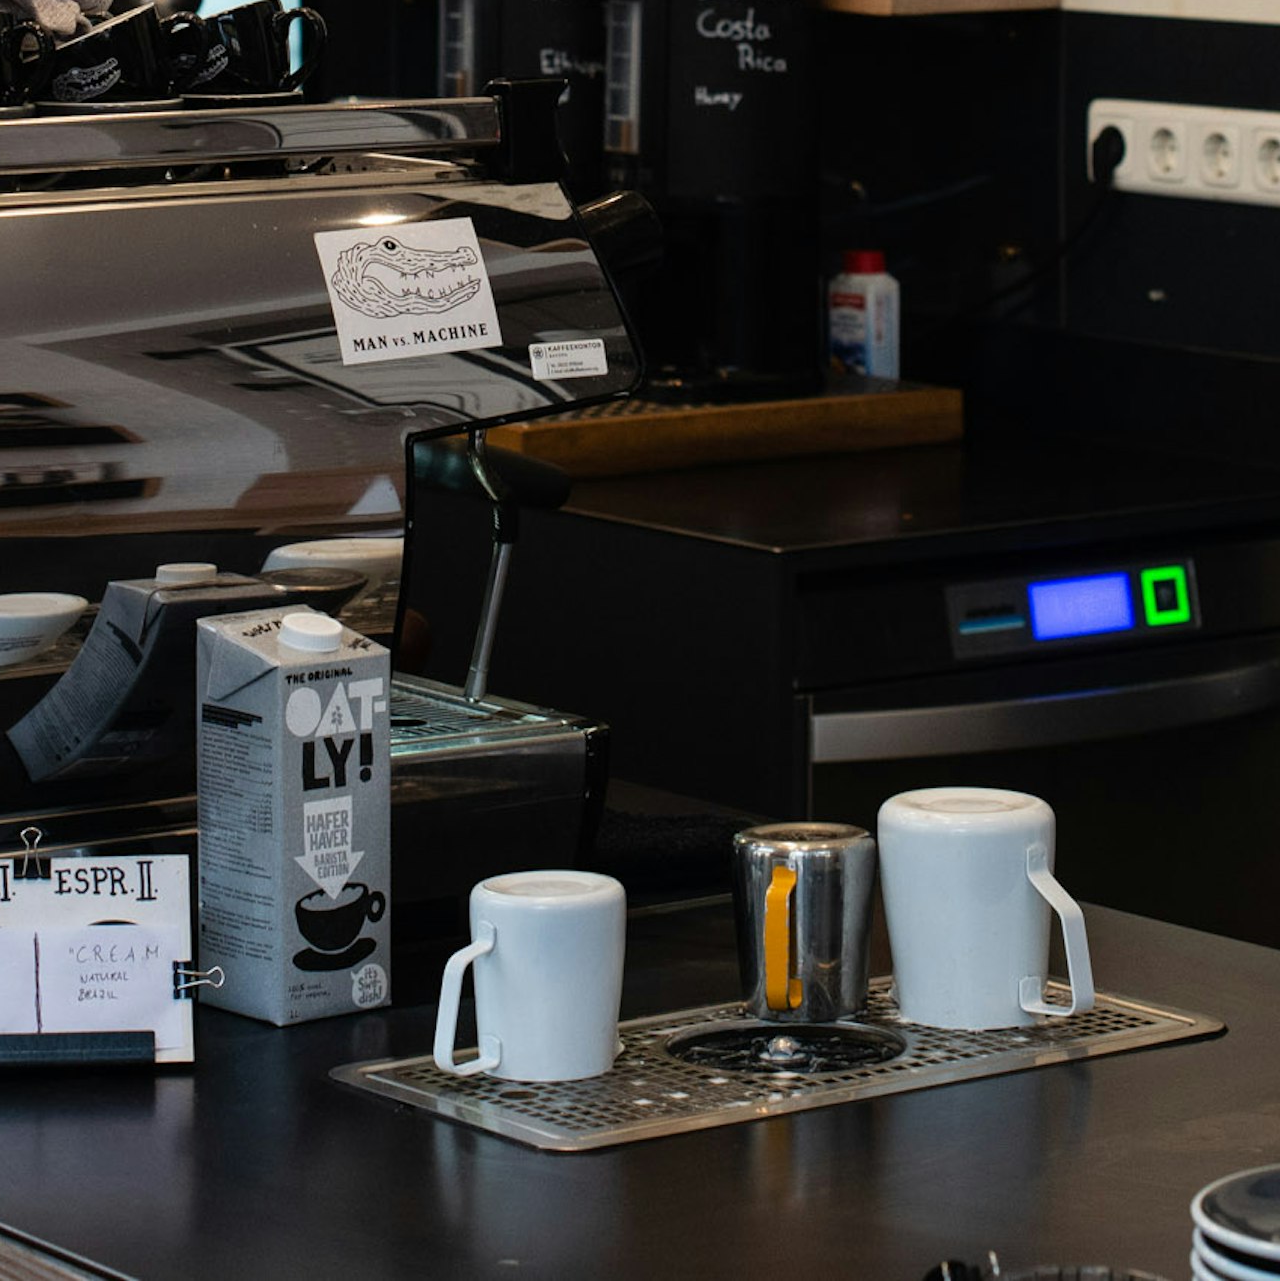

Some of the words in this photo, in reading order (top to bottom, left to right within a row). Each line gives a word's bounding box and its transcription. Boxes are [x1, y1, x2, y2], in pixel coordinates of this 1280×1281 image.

[696, 6, 771, 41] Costa
[737, 43, 788, 72] Rica
[353, 335, 388, 352] MAN
[392, 335, 410, 346] vs.
[413, 323, 488, 345] MACHINE
[286, 675, 305, 684] THE
[308, 667, 353, 681] ORIGINAL
[285, 677, 387, 737] OAT-
[303, 733, 374, 791] LY!
[307, 810, 350, 834] HAFER
[310, 831, 349, 852] HAVER
[314, 850, 347, 866] BARISTA
[318, 863, 349, 879] EDITION
